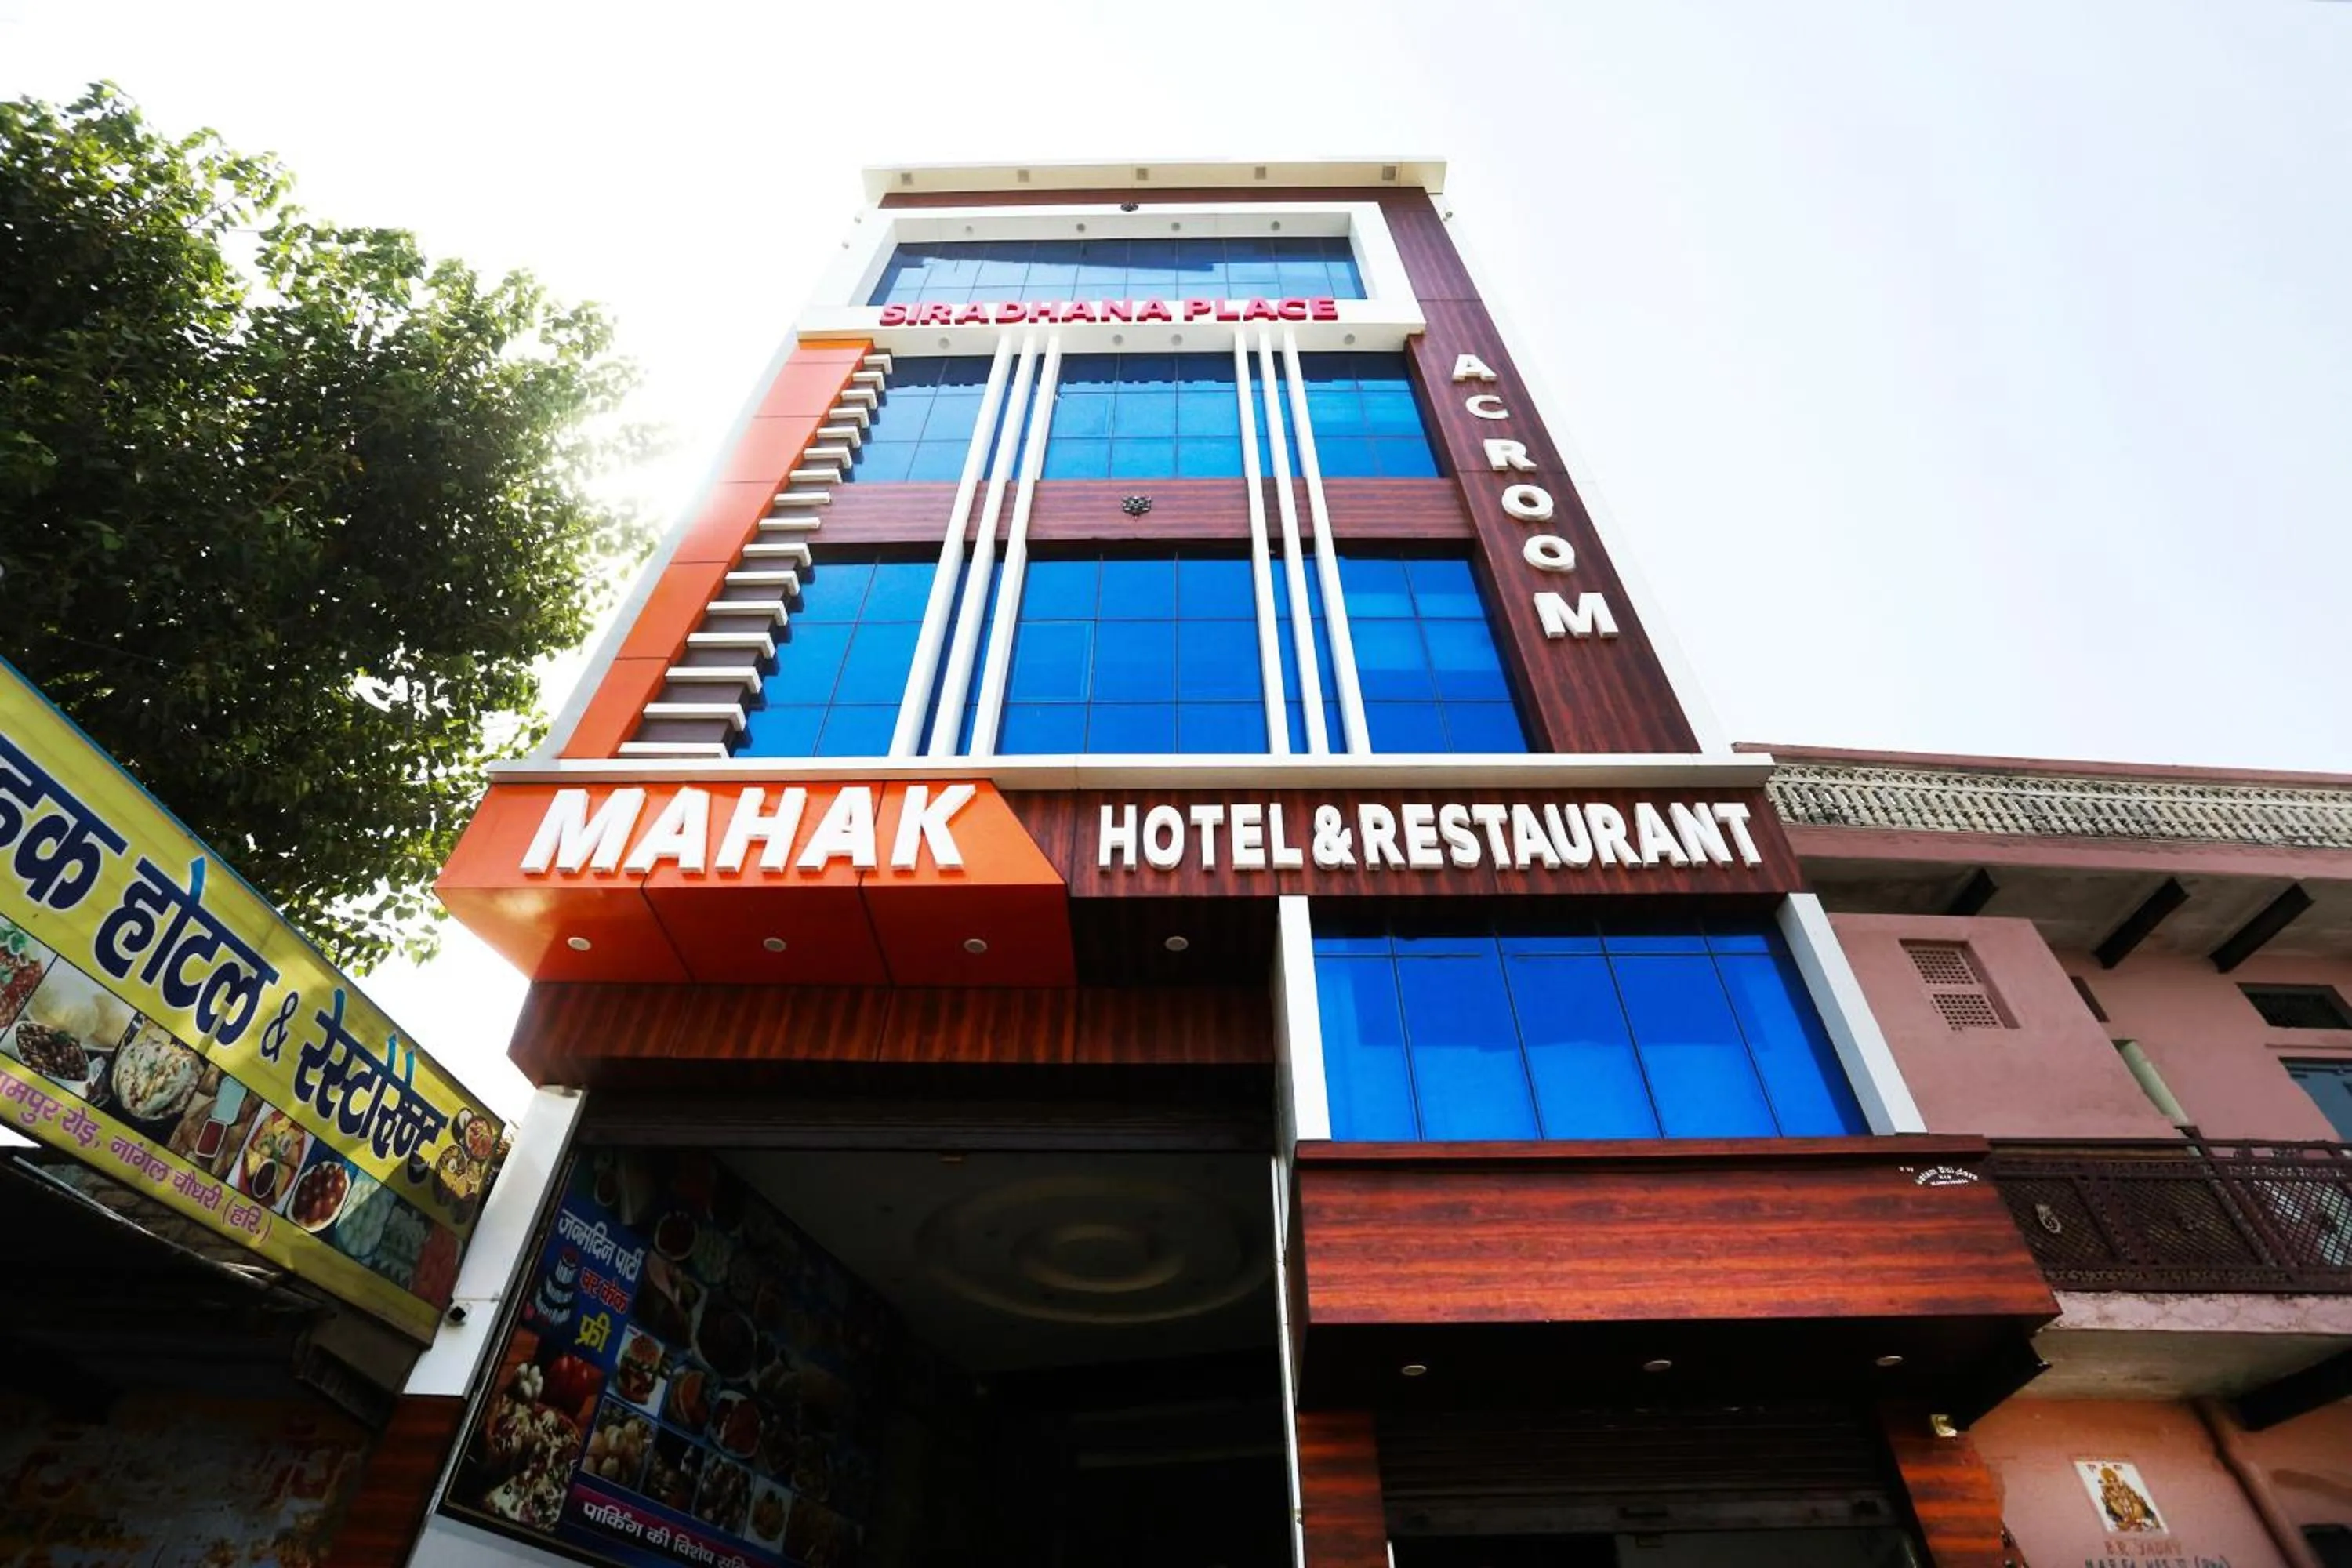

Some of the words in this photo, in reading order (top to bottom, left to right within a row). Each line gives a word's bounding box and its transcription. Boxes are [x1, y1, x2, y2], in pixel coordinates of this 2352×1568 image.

[879, 298, 1172, 326] SIRADHANA
[1183, 296, 1339, 323] PLACE
[519, 783, 977, 875] MAHAK
[1098, 802, 1303, 873] HOTEL
[94, 856, 280, 1047] होटल
[260, 990, 299, 1065] &
